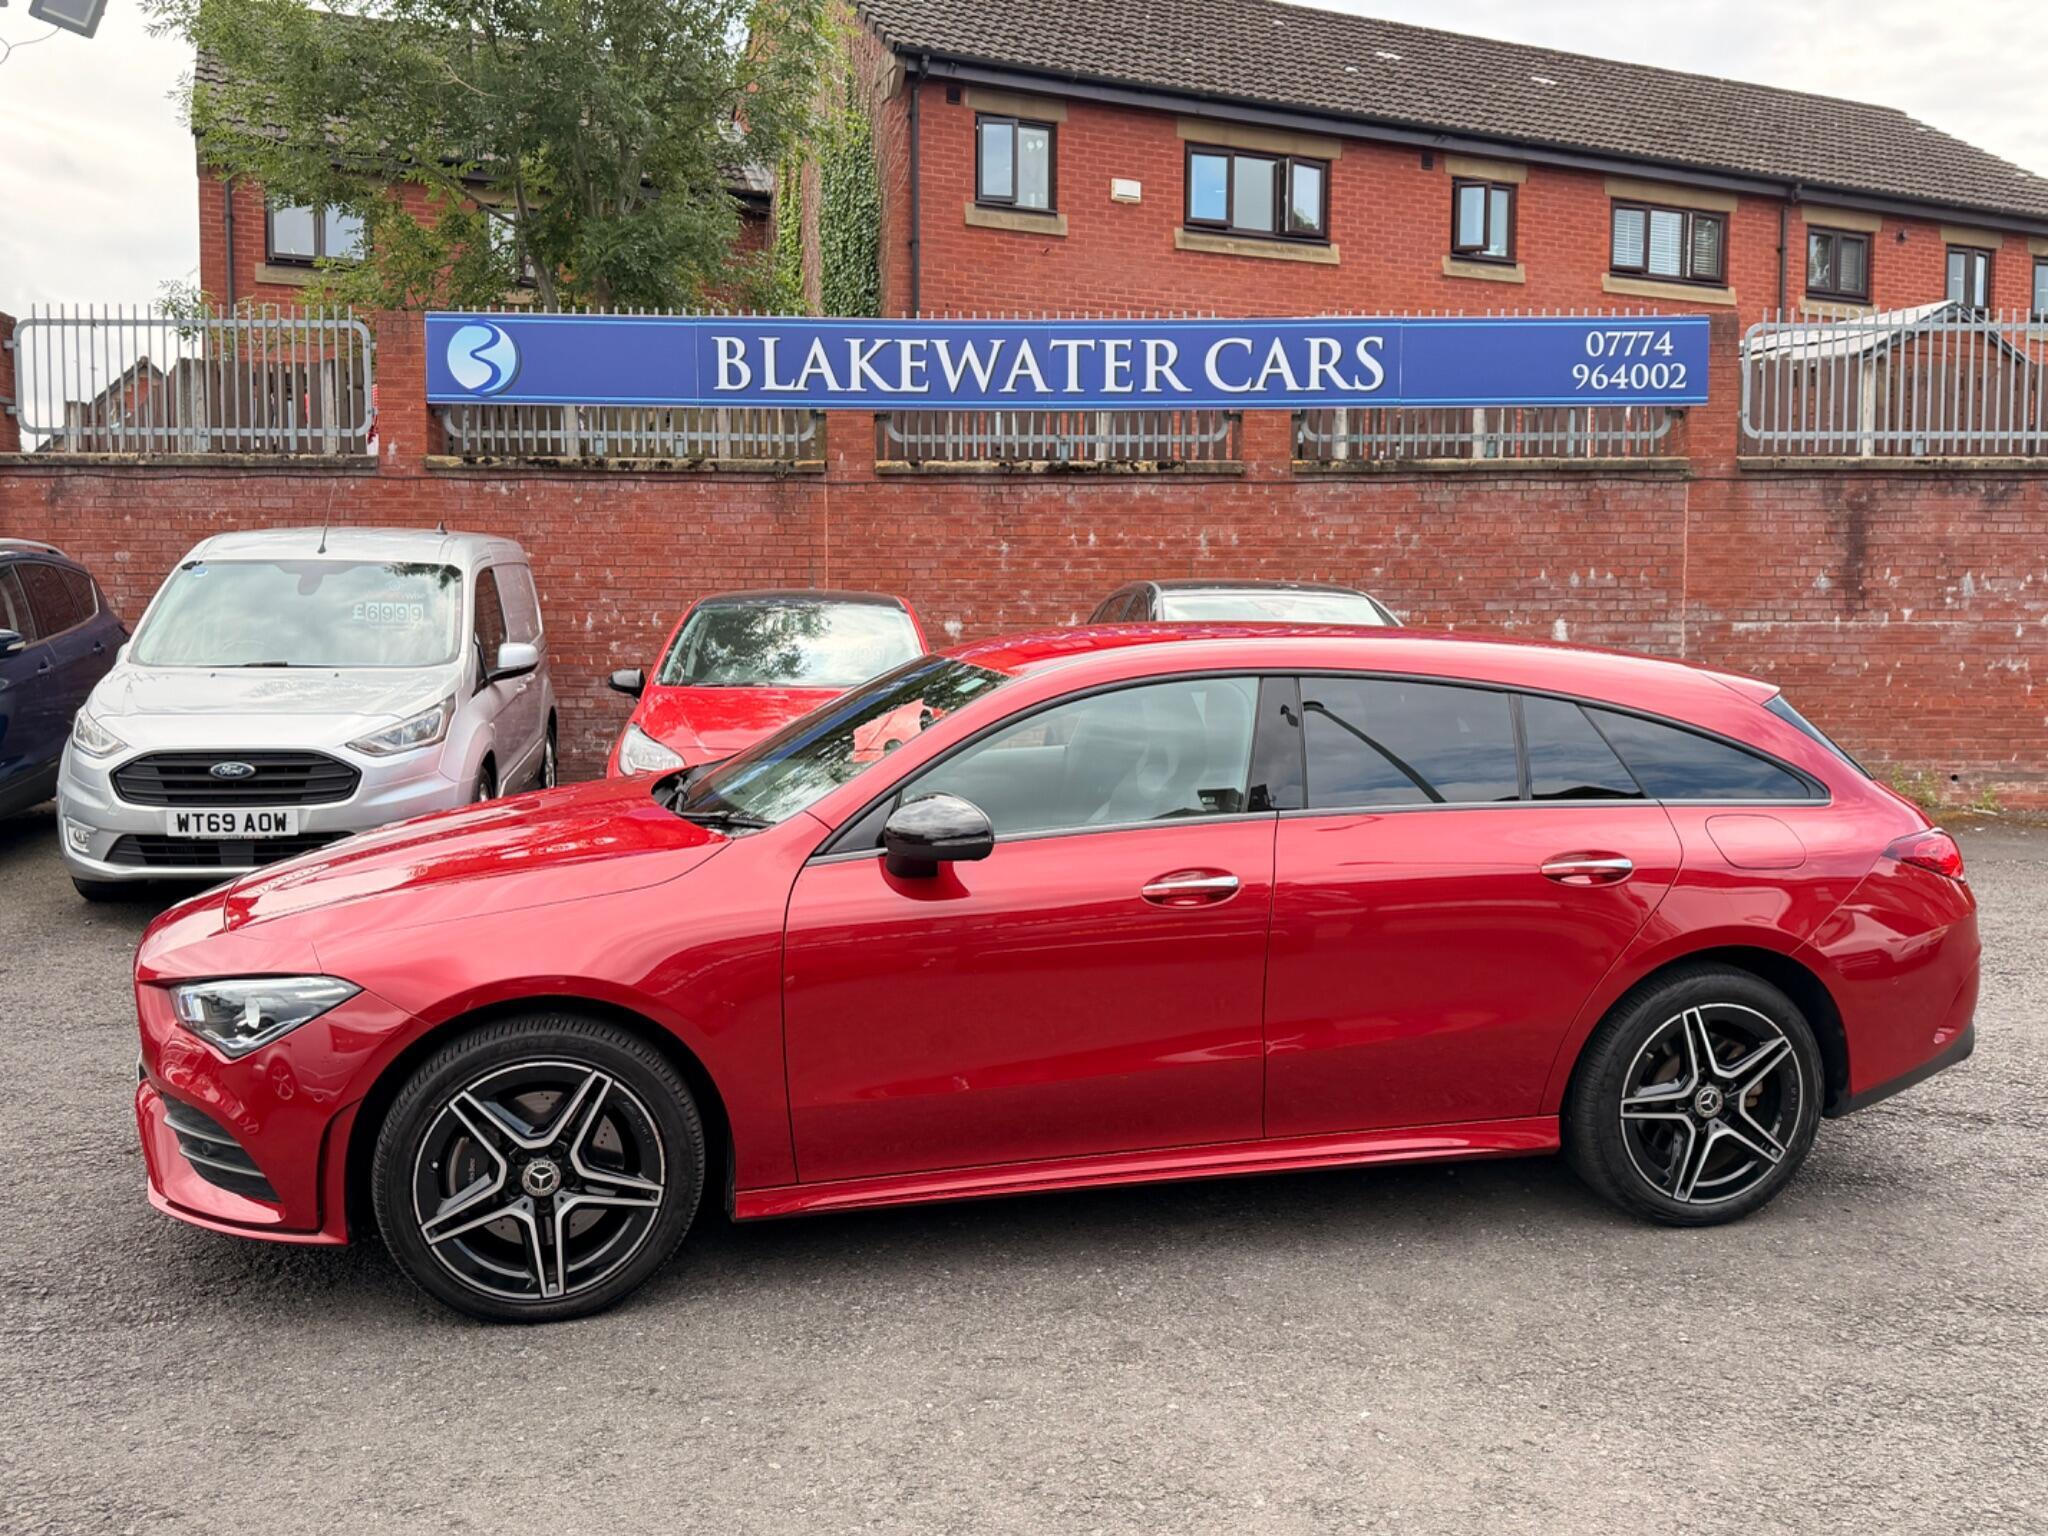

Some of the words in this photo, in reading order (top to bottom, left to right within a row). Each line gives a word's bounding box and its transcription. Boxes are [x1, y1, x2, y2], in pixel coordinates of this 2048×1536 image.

[1585, 330, 1674, 357] 07774
[711, 336, 1193, 394] BLAKEWATER
[1204, 336, 1385, 393] CARS
[1572, 362, 1687, 390] 964002
[176, 812, 236, 833] WT69
[243, 812, 287, 833] AOW
